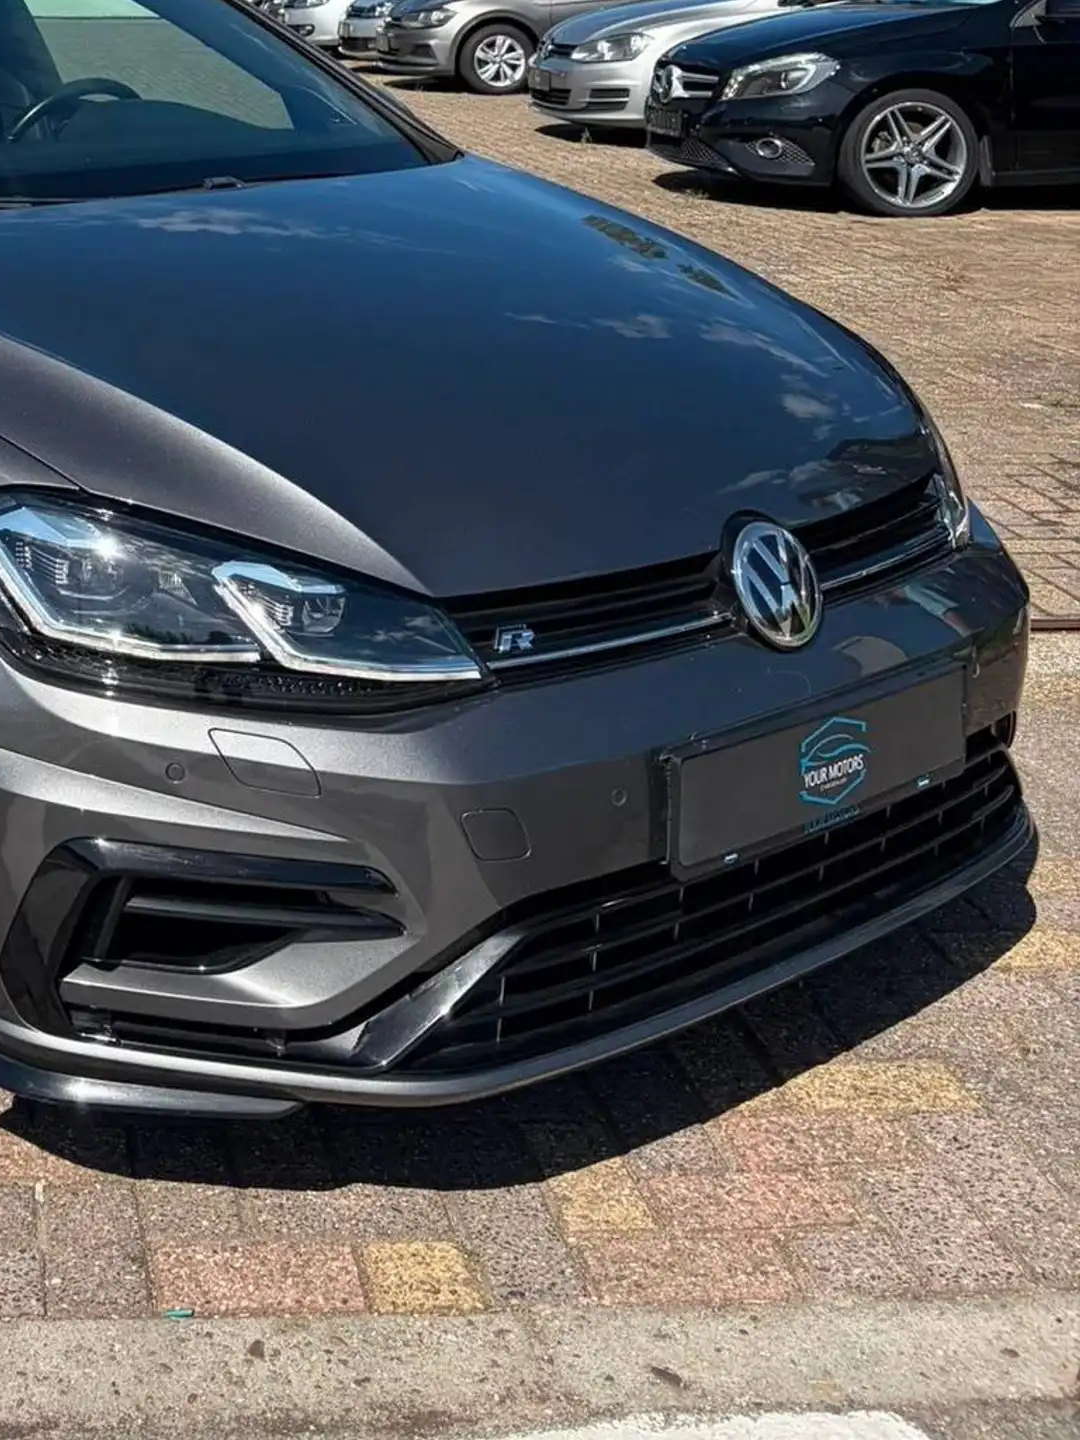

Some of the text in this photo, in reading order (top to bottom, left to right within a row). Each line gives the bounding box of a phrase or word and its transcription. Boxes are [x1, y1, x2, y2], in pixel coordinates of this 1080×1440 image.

[494, 624, 535, 654] R
[804, 766, 828, 788] YOUR
[829, 754, 864, 779] MOTORS
